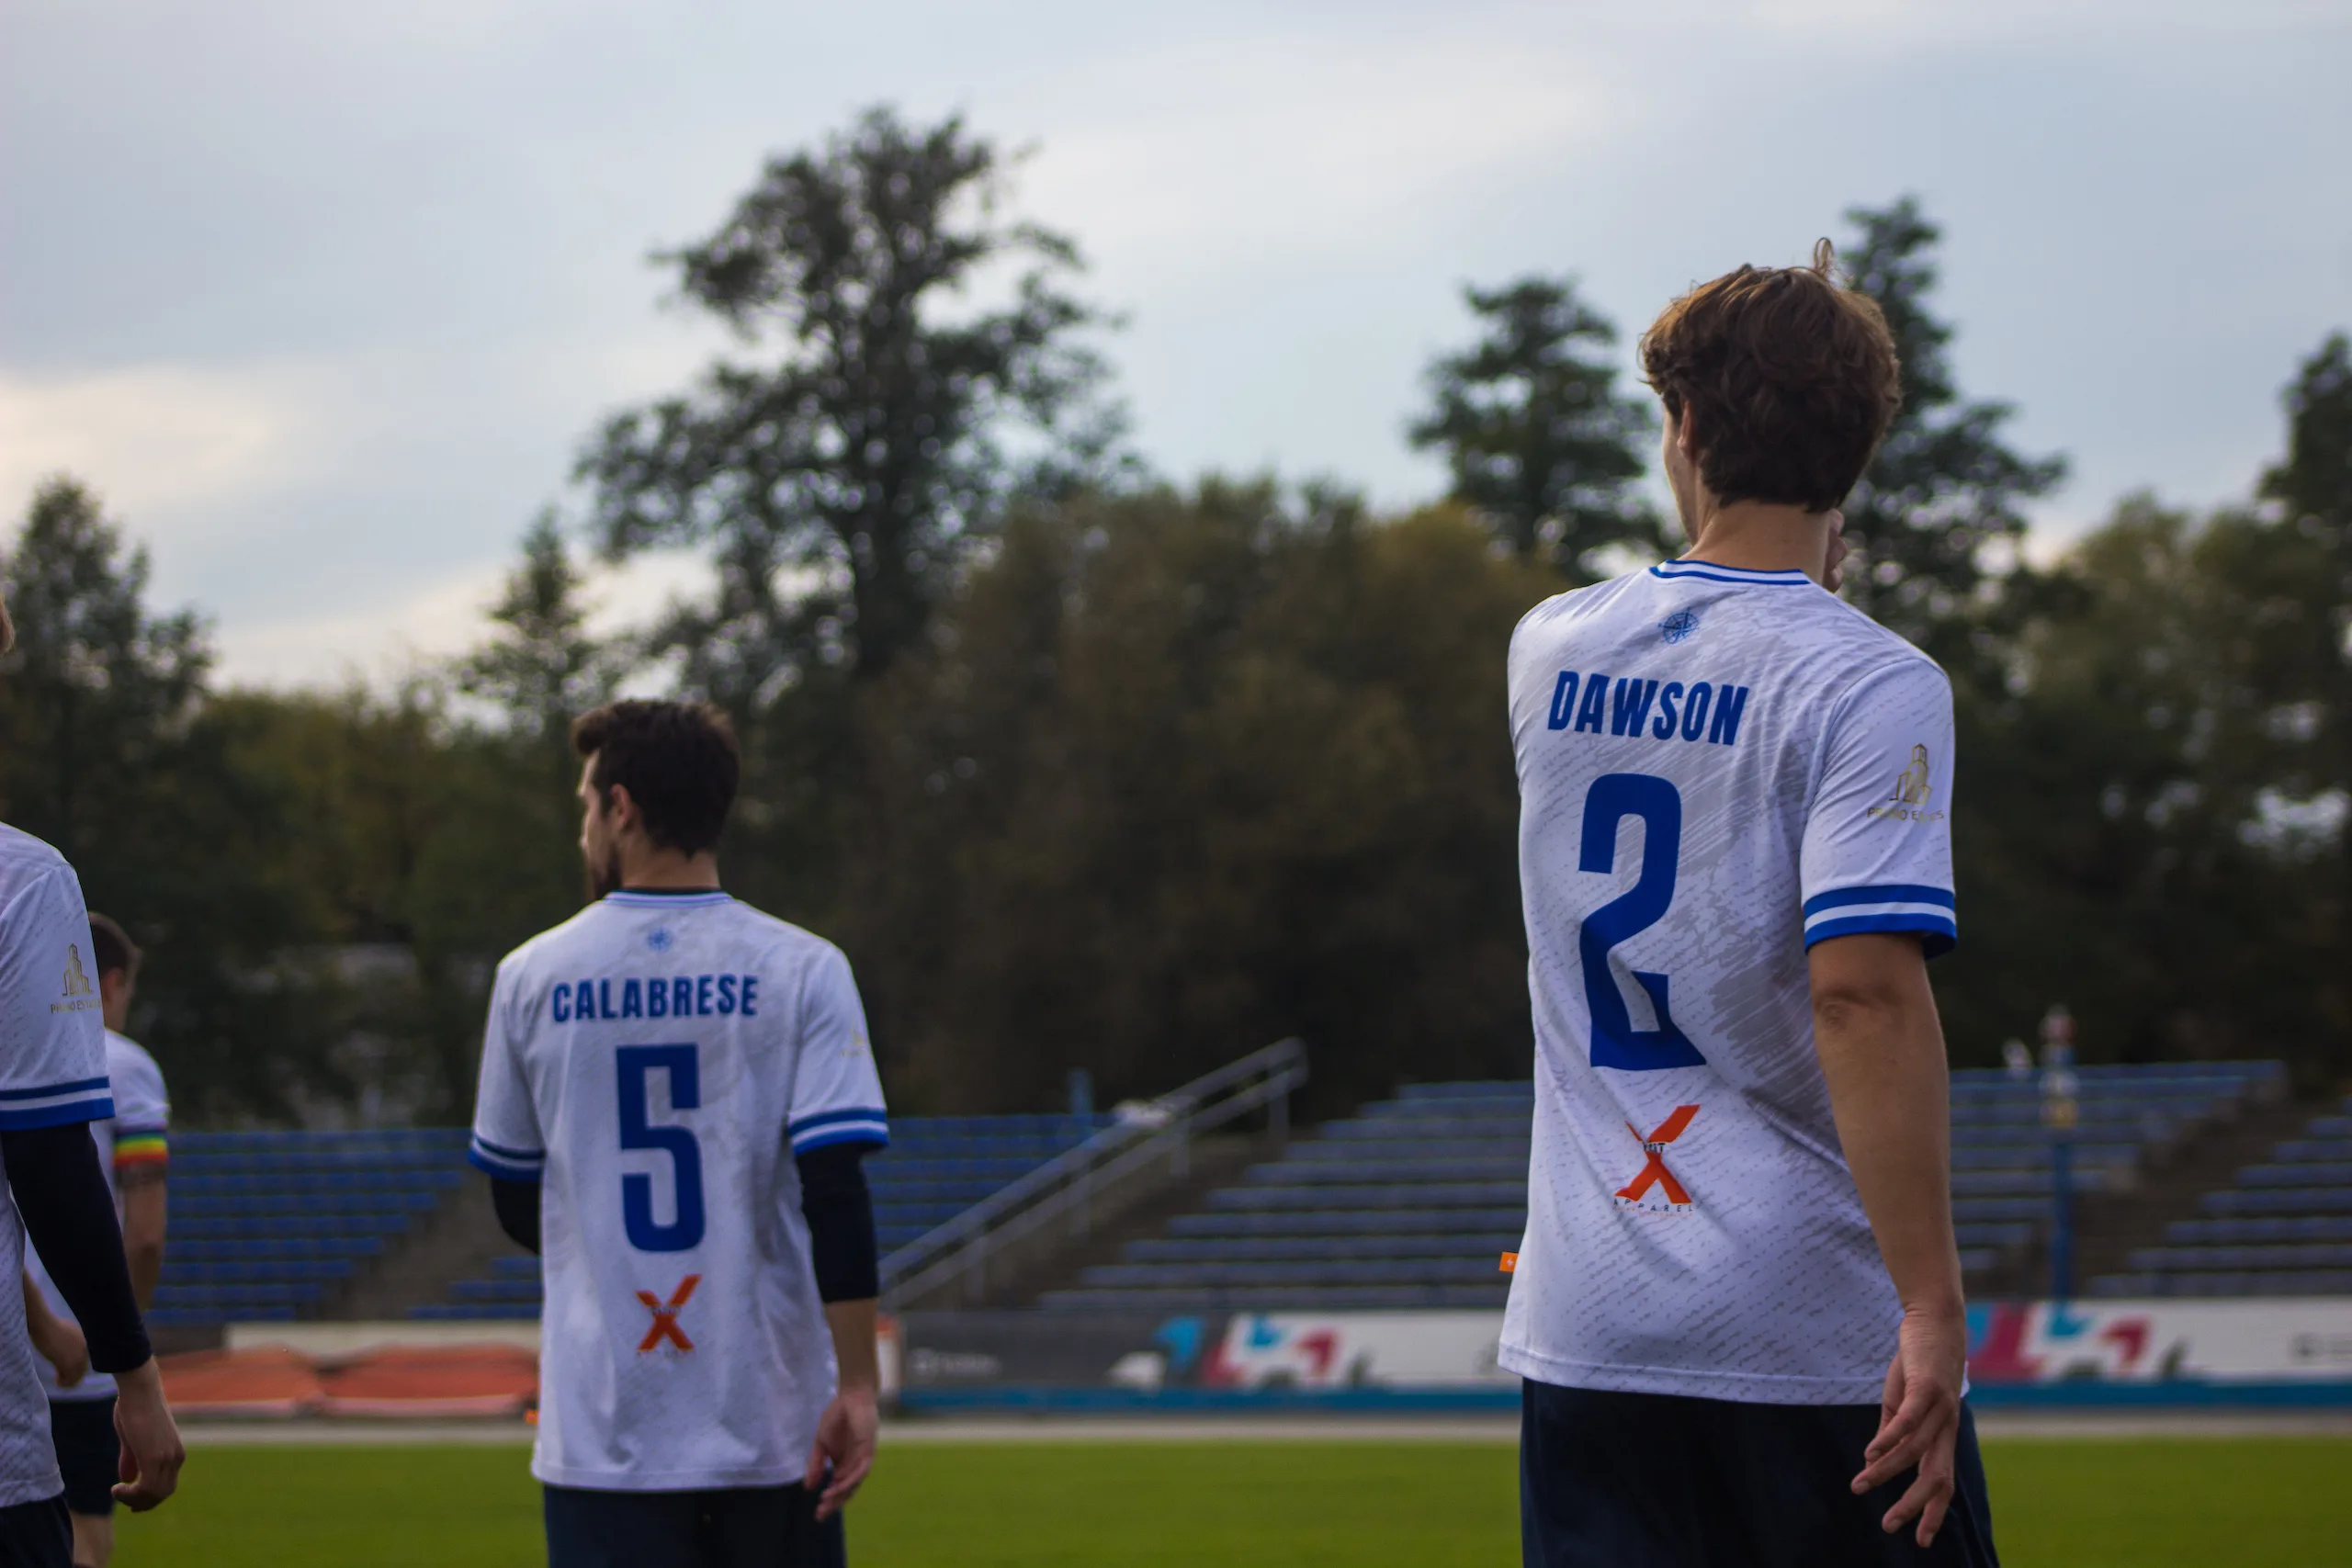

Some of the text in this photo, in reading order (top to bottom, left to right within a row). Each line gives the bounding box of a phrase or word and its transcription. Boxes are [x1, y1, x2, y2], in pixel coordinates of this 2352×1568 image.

[1547, 670, 1748, 746] DAWSON
[1578, 773, 1706, 1071] 2
[553, 974, 759, 1022] CALABRESE
[616, 1043, 706, 1252] 5
[1613, 1199, 1693, 1213] APPAREL
